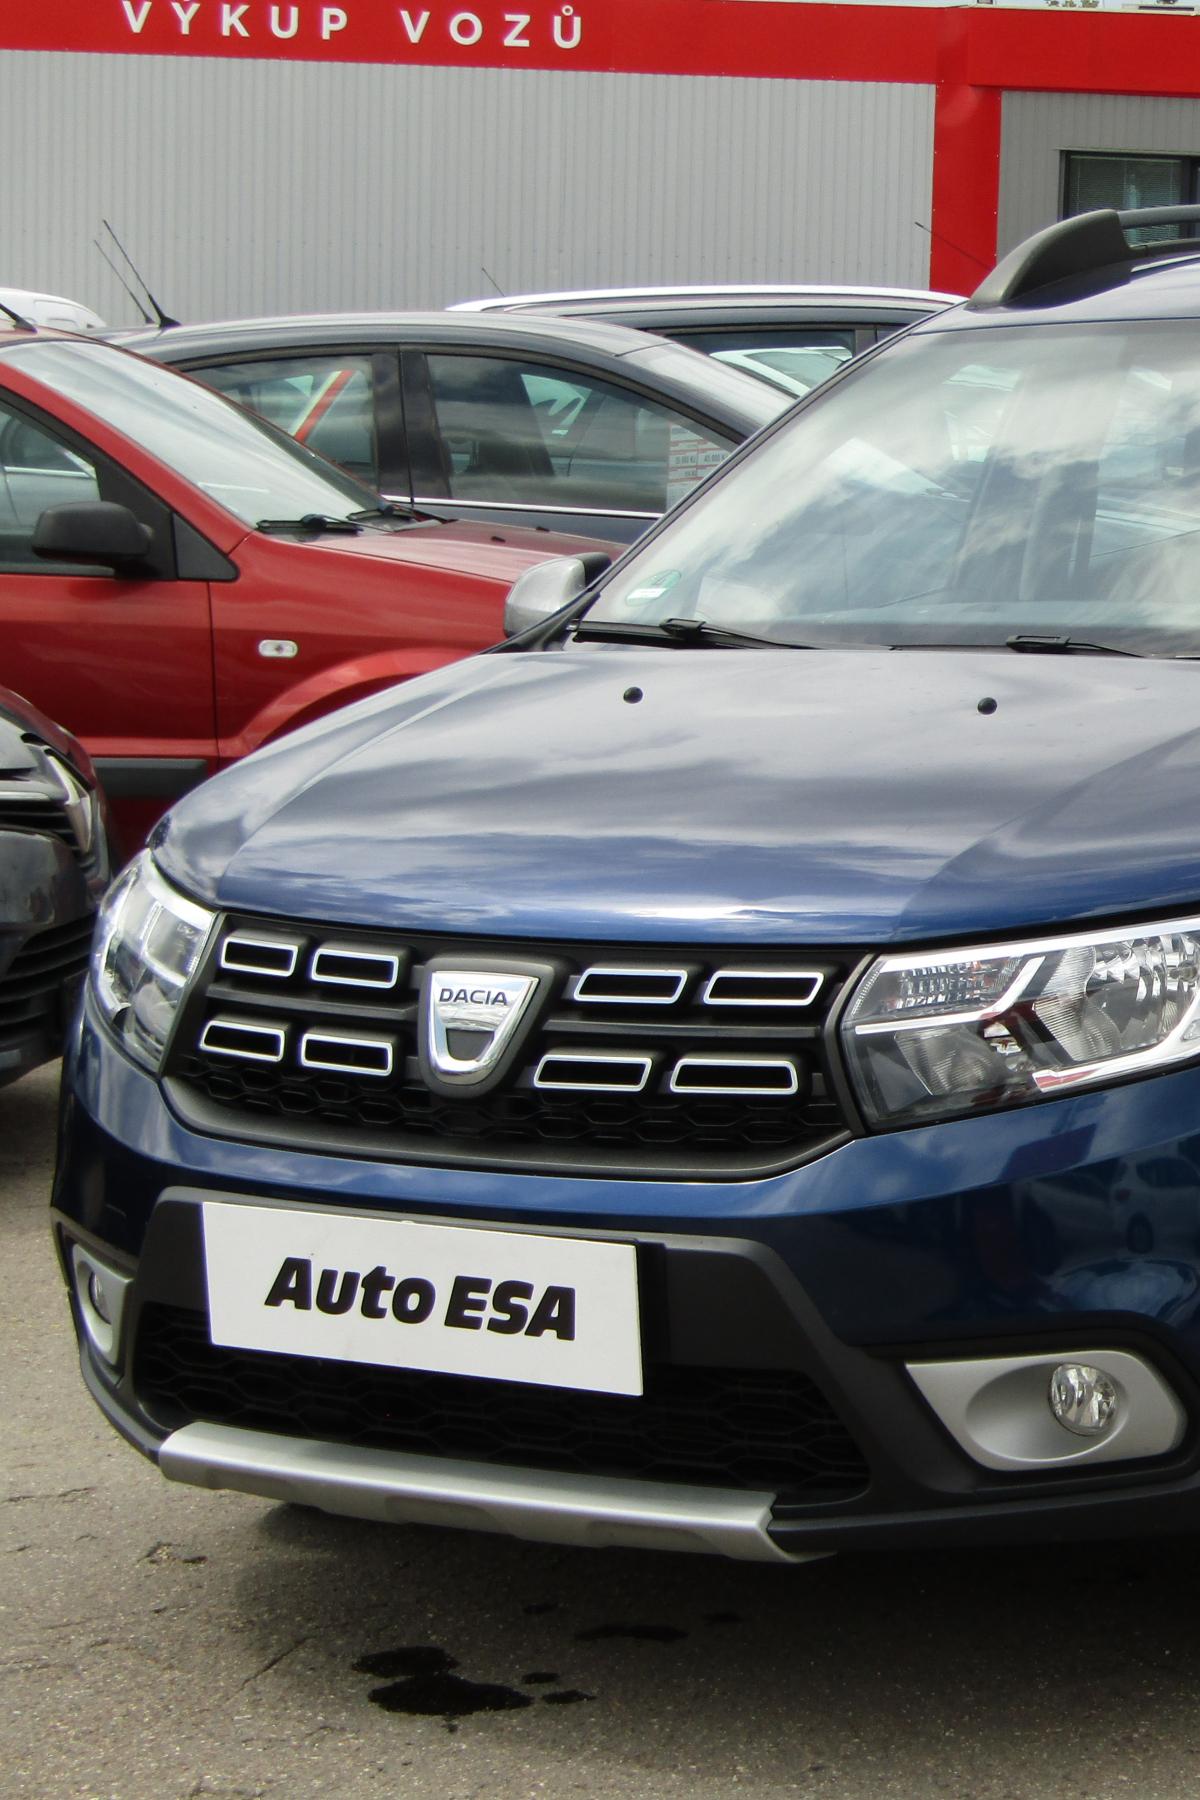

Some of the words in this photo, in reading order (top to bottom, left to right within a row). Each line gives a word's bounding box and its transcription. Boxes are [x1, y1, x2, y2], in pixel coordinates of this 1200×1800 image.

[122, 0, 348, 40] VÝKUP
[401, 5, 582, 48] VOZŮ
[439, 988, 508, 1006] DACIA
[264, 1257, 436, 1324] Auto
[444, 1275, 576, 1341] ESA
